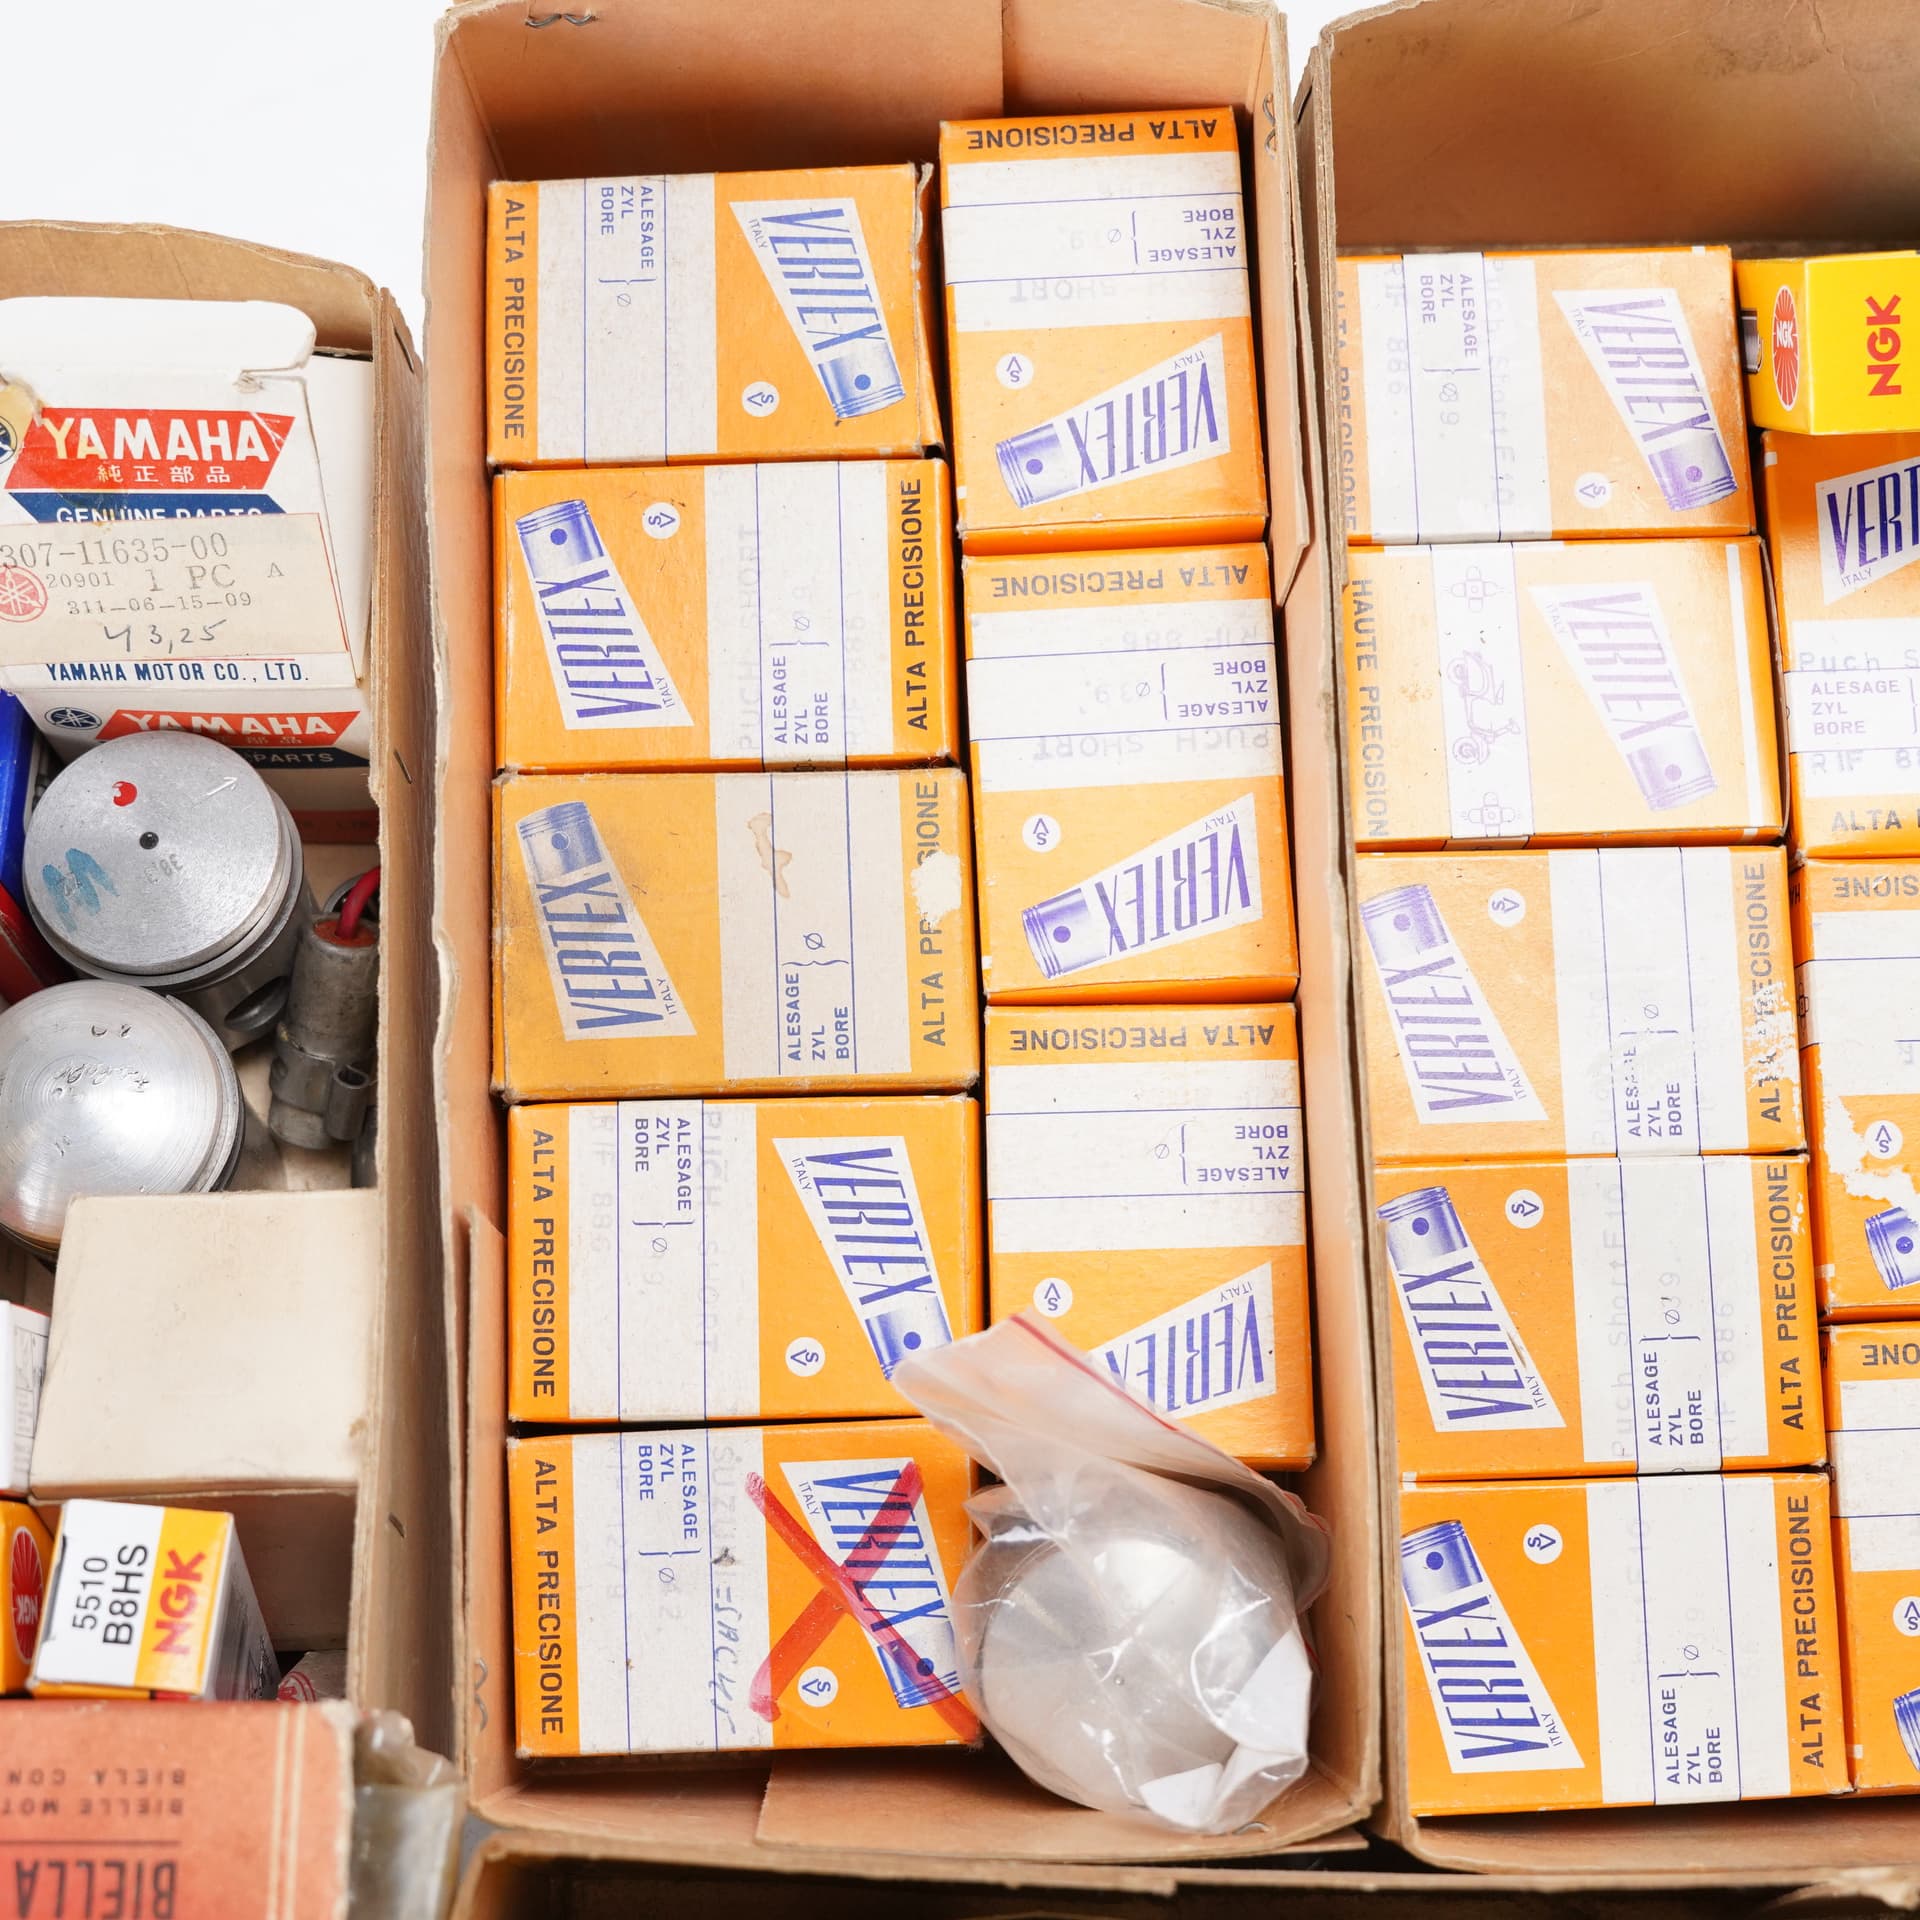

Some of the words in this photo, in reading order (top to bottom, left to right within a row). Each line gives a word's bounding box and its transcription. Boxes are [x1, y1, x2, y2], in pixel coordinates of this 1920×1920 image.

[967, 122, 1135, 150] PRECISIONE
[1150, 119, 1218, 140] ALTA
[601, 186, 614, 236] BORE
[621, 185, 634, 219] ZYL
[1183, 208, 1235, 222] BORE
[504, 198, 526, 263] ALTA
[640, 185, 654, 269] ALESAGE
[748, 218, 768, 249] ITALY
[1200, 226, 1236, 240] ZYL
[1149, 244, 1237, 262] ALESAGE
[761, 207, 887, 352] VERTEX
[1420, 274, 1435, 324] BORE
[1440, 273, 1455, 308] ZYL
[1459, 273, 1479, 358] ALESAGE
[1572, 308, 1592, 338] ITALY
[1776, 320, 1793, 349] NGK
[503, 277, 526, 440] PRECISIONE
[1173, 350, 1205, 371] ITALY
[1865, 294, 1902, 396] NGK
[1584, 296, 1715, 442] VERTEX
[41, 416, 271, 462] YAMAHA
[1066, 362, 1219, 488] VERTEX
[97, 465, 231, 484] 純正部品
[46, 571, 114, 588] 20901
[186, 563, 236, 590] PC
[901, 478, 926, 647] PRECISIONE
[1179, 564, 1249, 587] ALTA
[1840, 566, 1873, 588] ITALY
[991, 568, 1164, 598] PRECISIONE
[535, 569, 662, 719] VERTEX
[1352, 578, 1379, 672] HAUTE
[46, 663, 127, 682] YAMAHA
[135, 663, 205, 681] MOTOR
[264, 662, 310, 681] LTD.
[1213, 660, 1266, 675] BORE
[1231, 679, 1268, 693] ZYL
[1558, 592, 1694, 741] VERTEX
[654, 677, 675, 707] ITALY
[773, 655, 787, 744] ALESAGE
[907, 661, 928, 731] ALTA
[1810, 679, 1901, 695] ALESAGE
[122, 713, 337, 736] YAMAHA
[794, 708, 807, 745] ZYL
[816, 691, 829, 744] BORE
[1178, 699, 1269, 717] ALESAGE
[1812, 702, 1848, 715] ZYL
[1813, 720, 1866, 735] BORE
[254, 753, 335, 764] PARTS
[1358, 686, 1390, 838] PRECISION
[1204, 810, 1237, 832] ITALY
[1831, 809, 1902, 832] ALTA
[1095, 822, 1251, 956] VERTEX
[537, 872, 664, 1030] VERTEX
[656, 978, 678, 1015] ITALY
[921, 972, 946, 1047] ALTA
[787, 973, 801, 1061] ALESAGE
[836, 1006, 850, 1060] BORE
[1204, 1024, 1275, 1046] ALTA
[1384, 956, 1514, 1111] VERTEX
[812, 1024, 826, 1061] ZYL
[1010, 1026, 1187, 1051] PRECISIONE
[1505, 1068, 1527, 1100] ITALY
[1648, 1100, 1663, 1137] ZYL
[1667, 1082, 1683, 1136] BORE
[635, 1118, 649, 1173] BORE
[656, 1118, 669, 1154] ZYL
[1234, 1124, 1289, 1139] BORE
[533, 1129, 555, 1202] ALTA
[677, 1118, 691, 1211] ALESAGE
[1253, 1145, 1290, 1160] ZYL
[791, 1157, 813, 1192] ITALY
[1197, 1166, 1290, 1182] ALESAGE
[806, 1147, 936, 1305] VERTEX
[1767, 1164, 1799, 1342] PRECISIONE
[532, 1218, 555, 1398] PRECISIONE
[1220, 1281, 1253, 1302] ITALY
[1399, 1261, 1534, 1421] VERTEX
[1525, 1375, 1547, 1408] ITALY
[1643, 1351, 1662, 1446] ALESAGE
[1780, 1356, 1804, 1431] ALTA
[1669, 1407, 1684, 1446] ZYL
[1690, 1389, 1704, 1444] BORE
[638, 1445, 654, 1501] BORE
[659, 1444, 677, 1482] ZYL
[533, 1459, 558, 1535] ALTA
[681, 1444, 699, 1540] ALESAGE
[797, 1481, 819, 1516] ITALY
[813, 1470, 949, 1632] VERTEX
[72, 1557, 108, 1630] 5510
[102, 1544, 149, 1646] B8HS
[152, 1549, 206, 1656] NGK
[1787, 1494, 1819, 1678] PRECISIONE
[16, 1593, 38, 1626] NGK
[537, 1549, 564, 1736] PRECISIONE
[1413, 1594, 1549, 1759] VERTEX
[1540, 1712, 1563, 1747] ITALY
[1663, 1687, 1681, 1784] ALESAGE
[1801, 1692, 1825, 1769] ALTA
[1686, 1745, 1702, 1784] ZYL
[1707, 1725, 1723, 1783] BORE
[9, 1769, 66, 1785] CON
[94, 1769, 185, 1785] BIELLA
[80, 1799, 183, 1815] BIELLE
[15, 1859, 178, 1919] BIELLA
